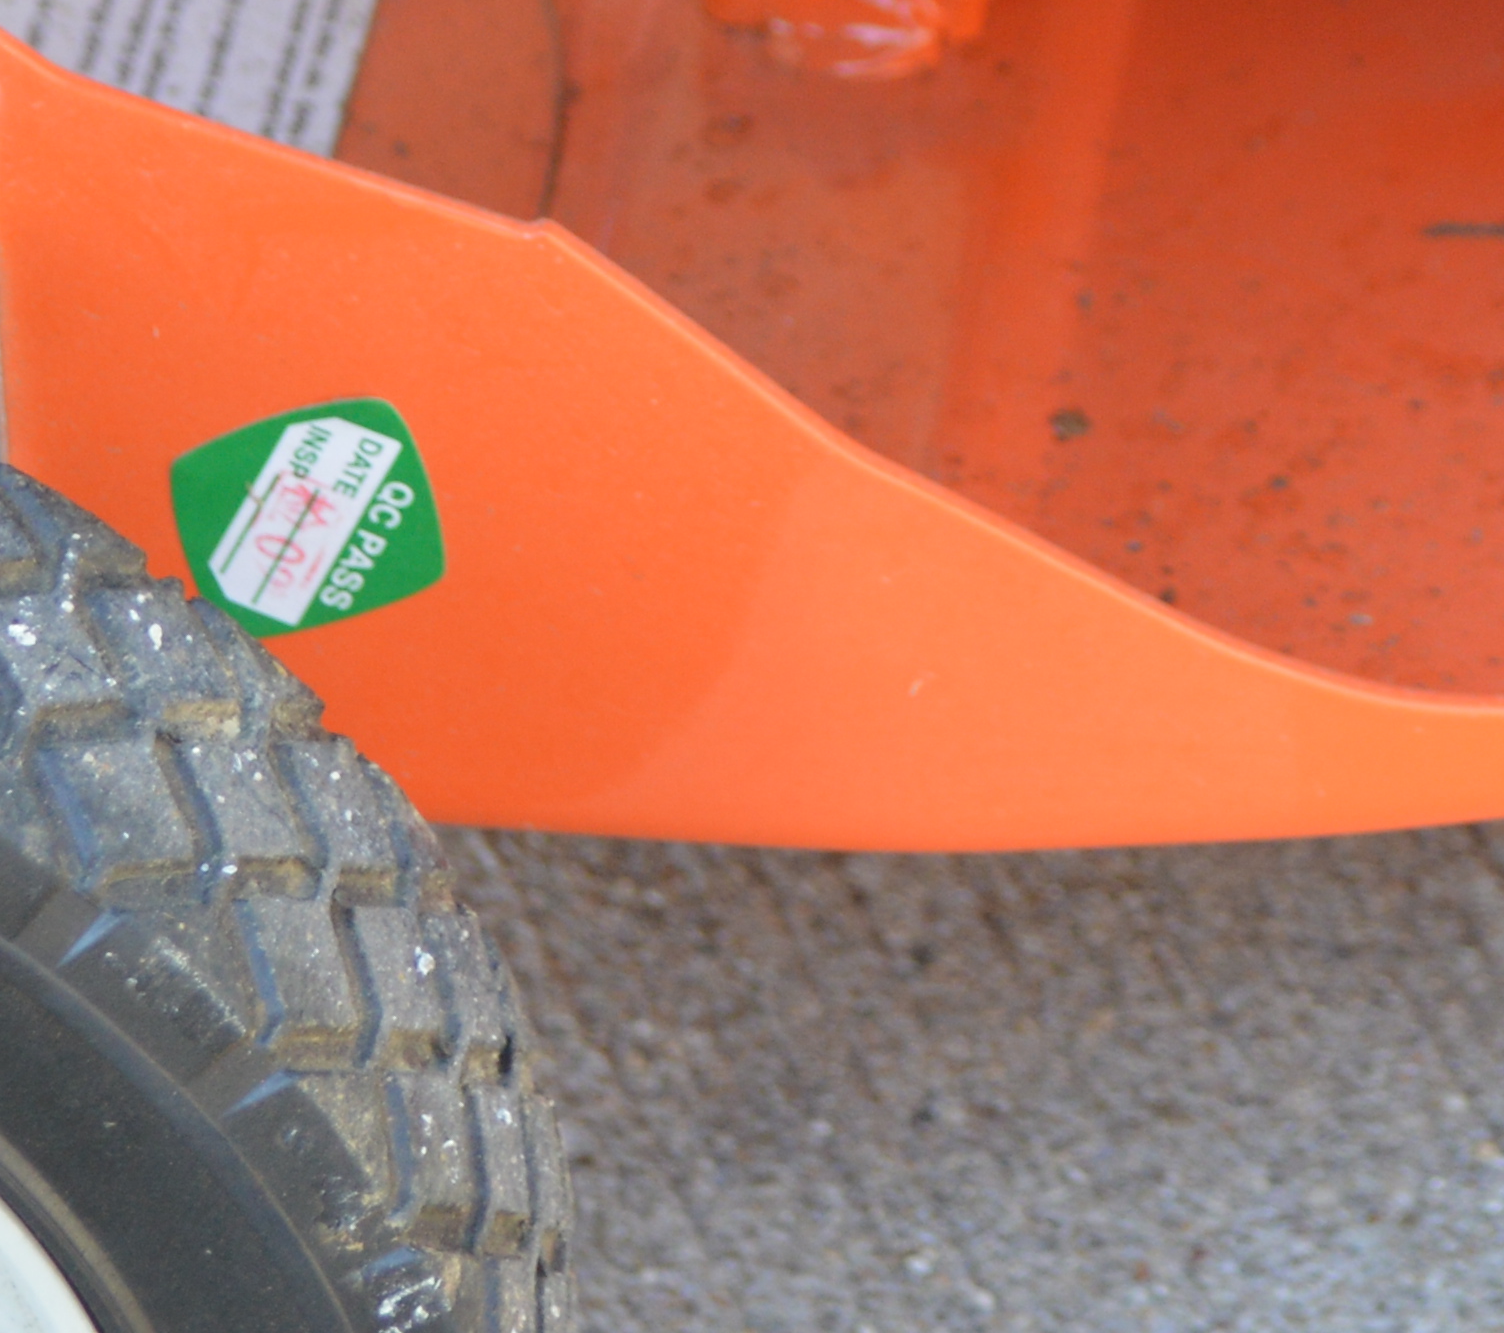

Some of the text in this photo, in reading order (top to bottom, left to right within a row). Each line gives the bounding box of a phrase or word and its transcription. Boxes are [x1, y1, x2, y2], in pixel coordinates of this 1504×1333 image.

[288, 423, 333, 480] INSP
[332, 436, 384, 500] DATE
[318, 480, 415, 611] QC PASS
